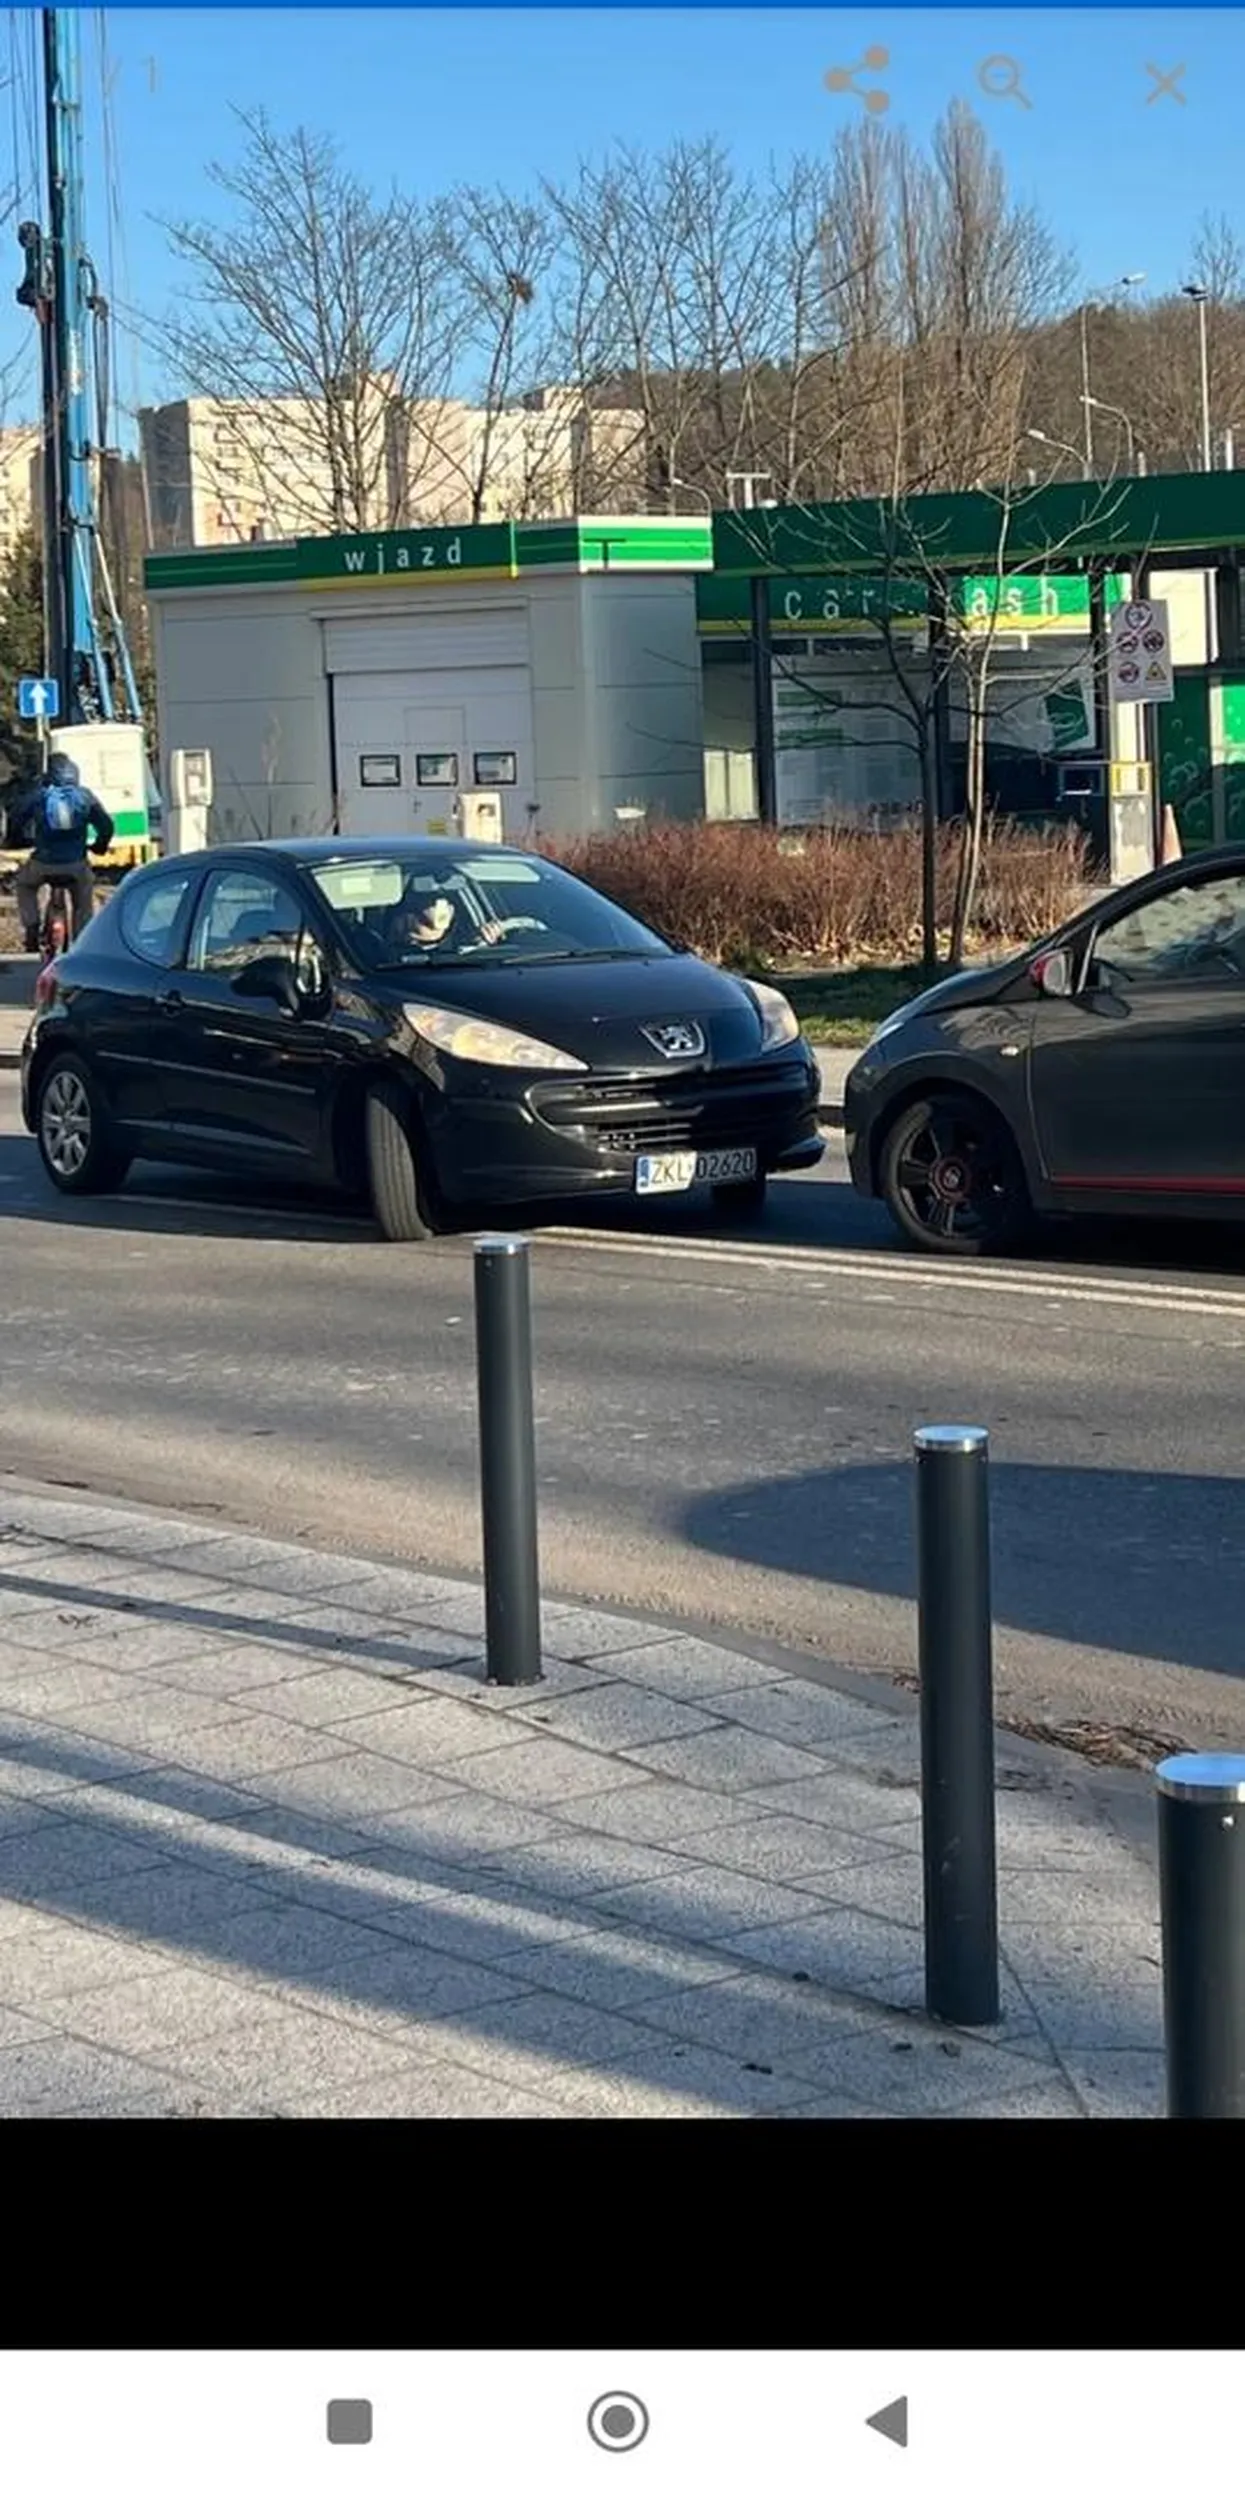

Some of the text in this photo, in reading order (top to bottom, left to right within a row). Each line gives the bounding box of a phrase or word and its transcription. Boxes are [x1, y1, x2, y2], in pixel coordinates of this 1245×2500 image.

[344, 536, 461, 575] wjazd
[784, 579, 1060, 619] car ash
[652, 1151, 753, 1184] ZKL 02620
